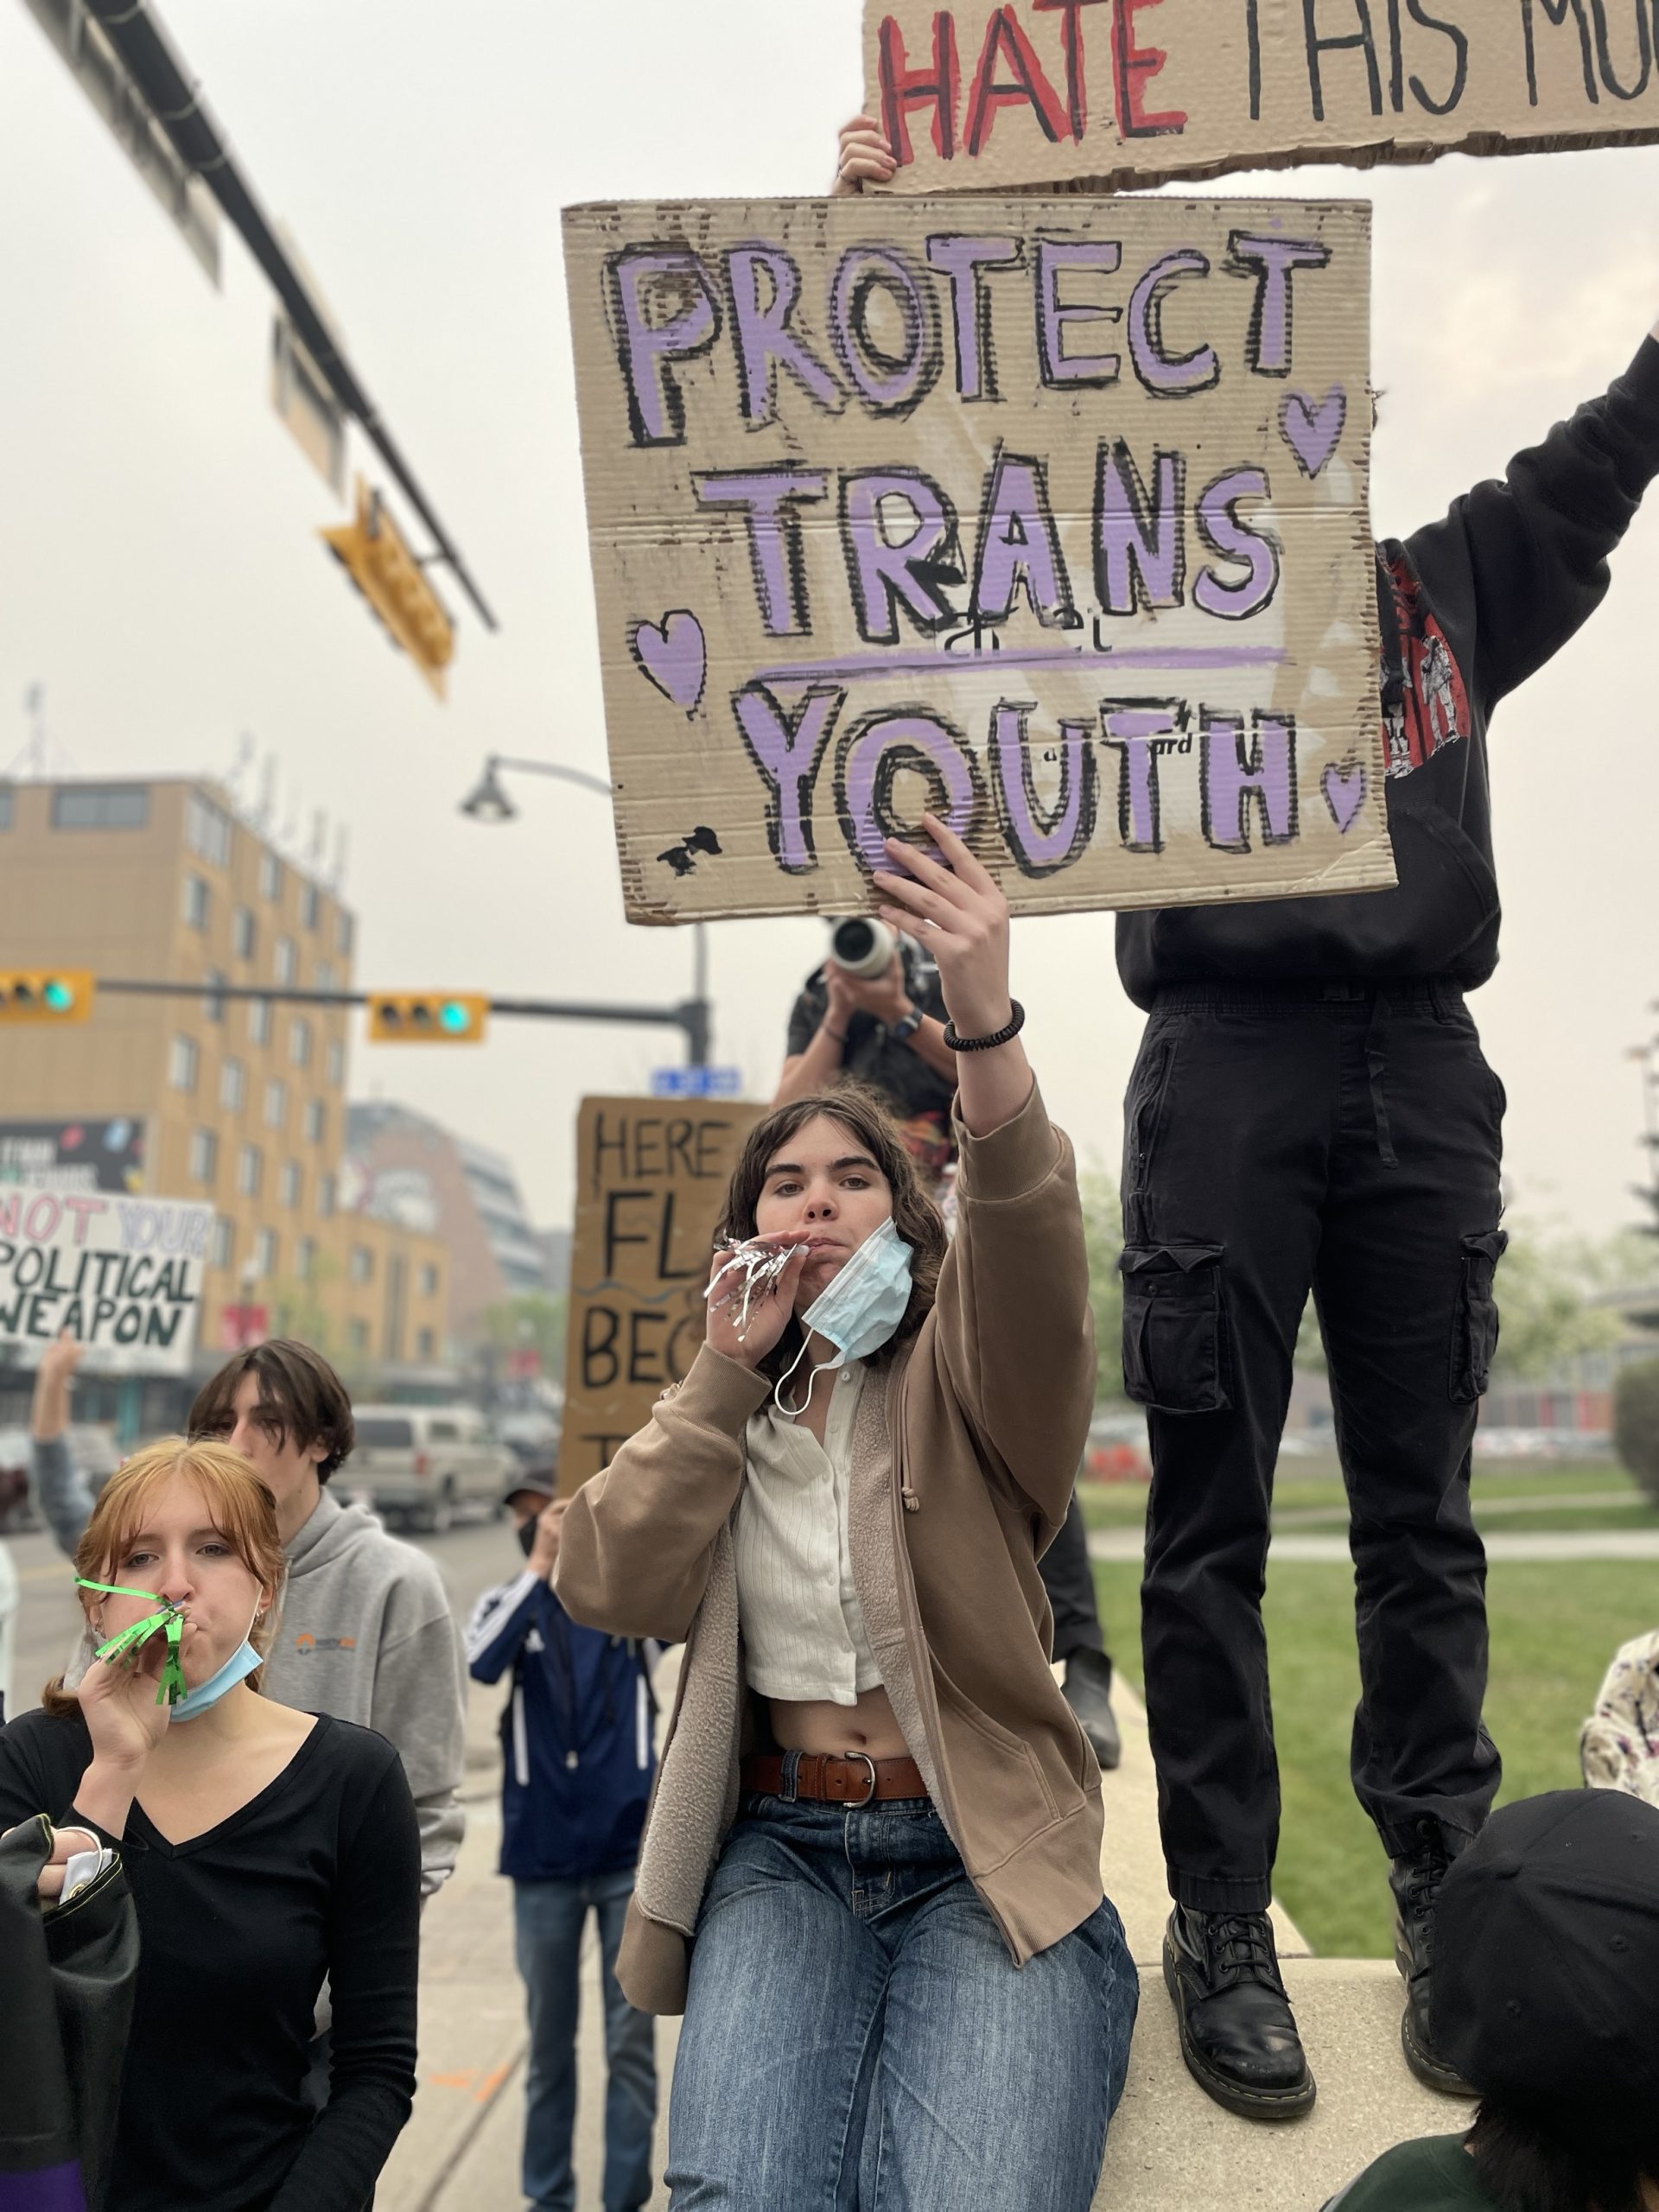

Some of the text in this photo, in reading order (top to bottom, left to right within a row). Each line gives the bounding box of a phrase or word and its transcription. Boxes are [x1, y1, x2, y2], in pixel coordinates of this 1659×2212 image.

[877, 0, 1189, 168] HATE
[601, 230, 1332, 448] PROTECT
[690, 436, 1285, 644] TRANS
[729, 678, 1303, 879] YOUTH
[118, 1201, 208, 1256] YOUR
[594, 1109, 734, 1179] HERE
